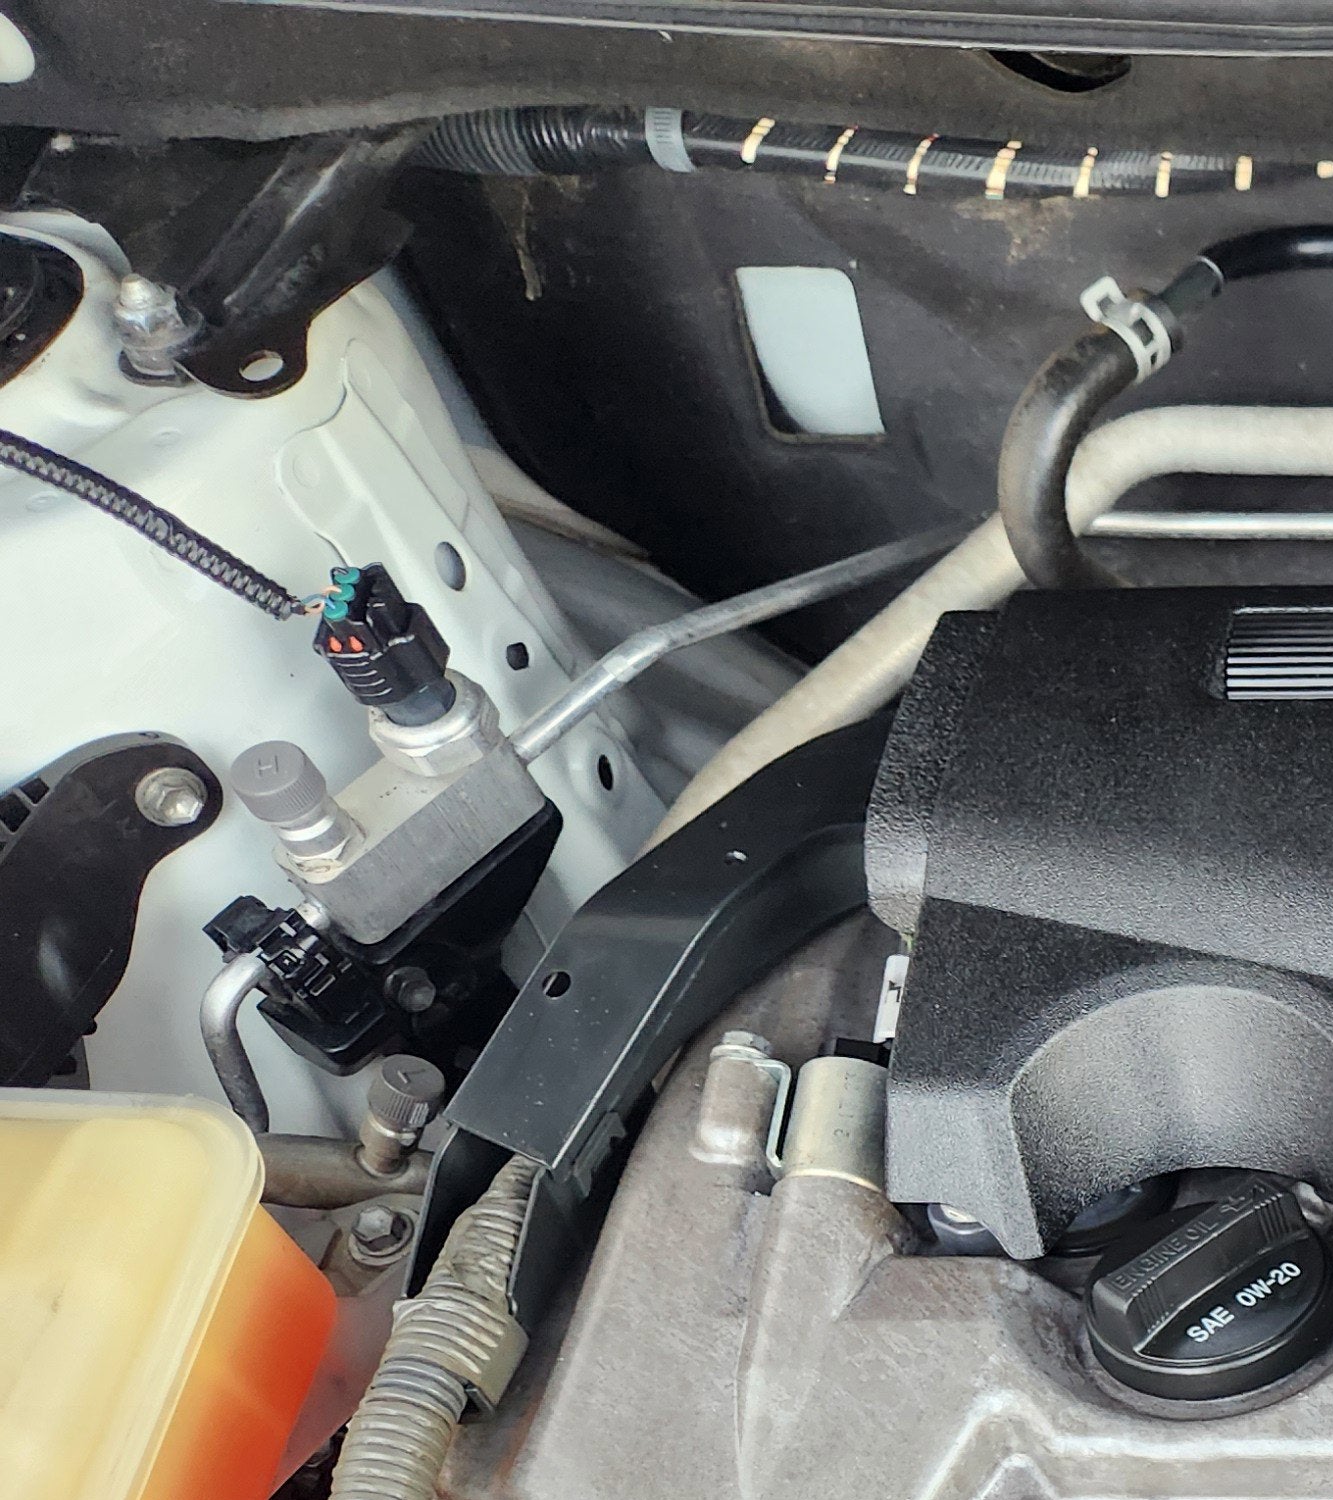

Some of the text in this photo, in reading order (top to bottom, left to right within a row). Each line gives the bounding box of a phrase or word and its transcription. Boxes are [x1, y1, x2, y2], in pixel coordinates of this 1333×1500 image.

[1114, 1219, 1219, 1290] ENGINE OIL
[1186, 1261, 1302, 1343] SAE 0W-20
